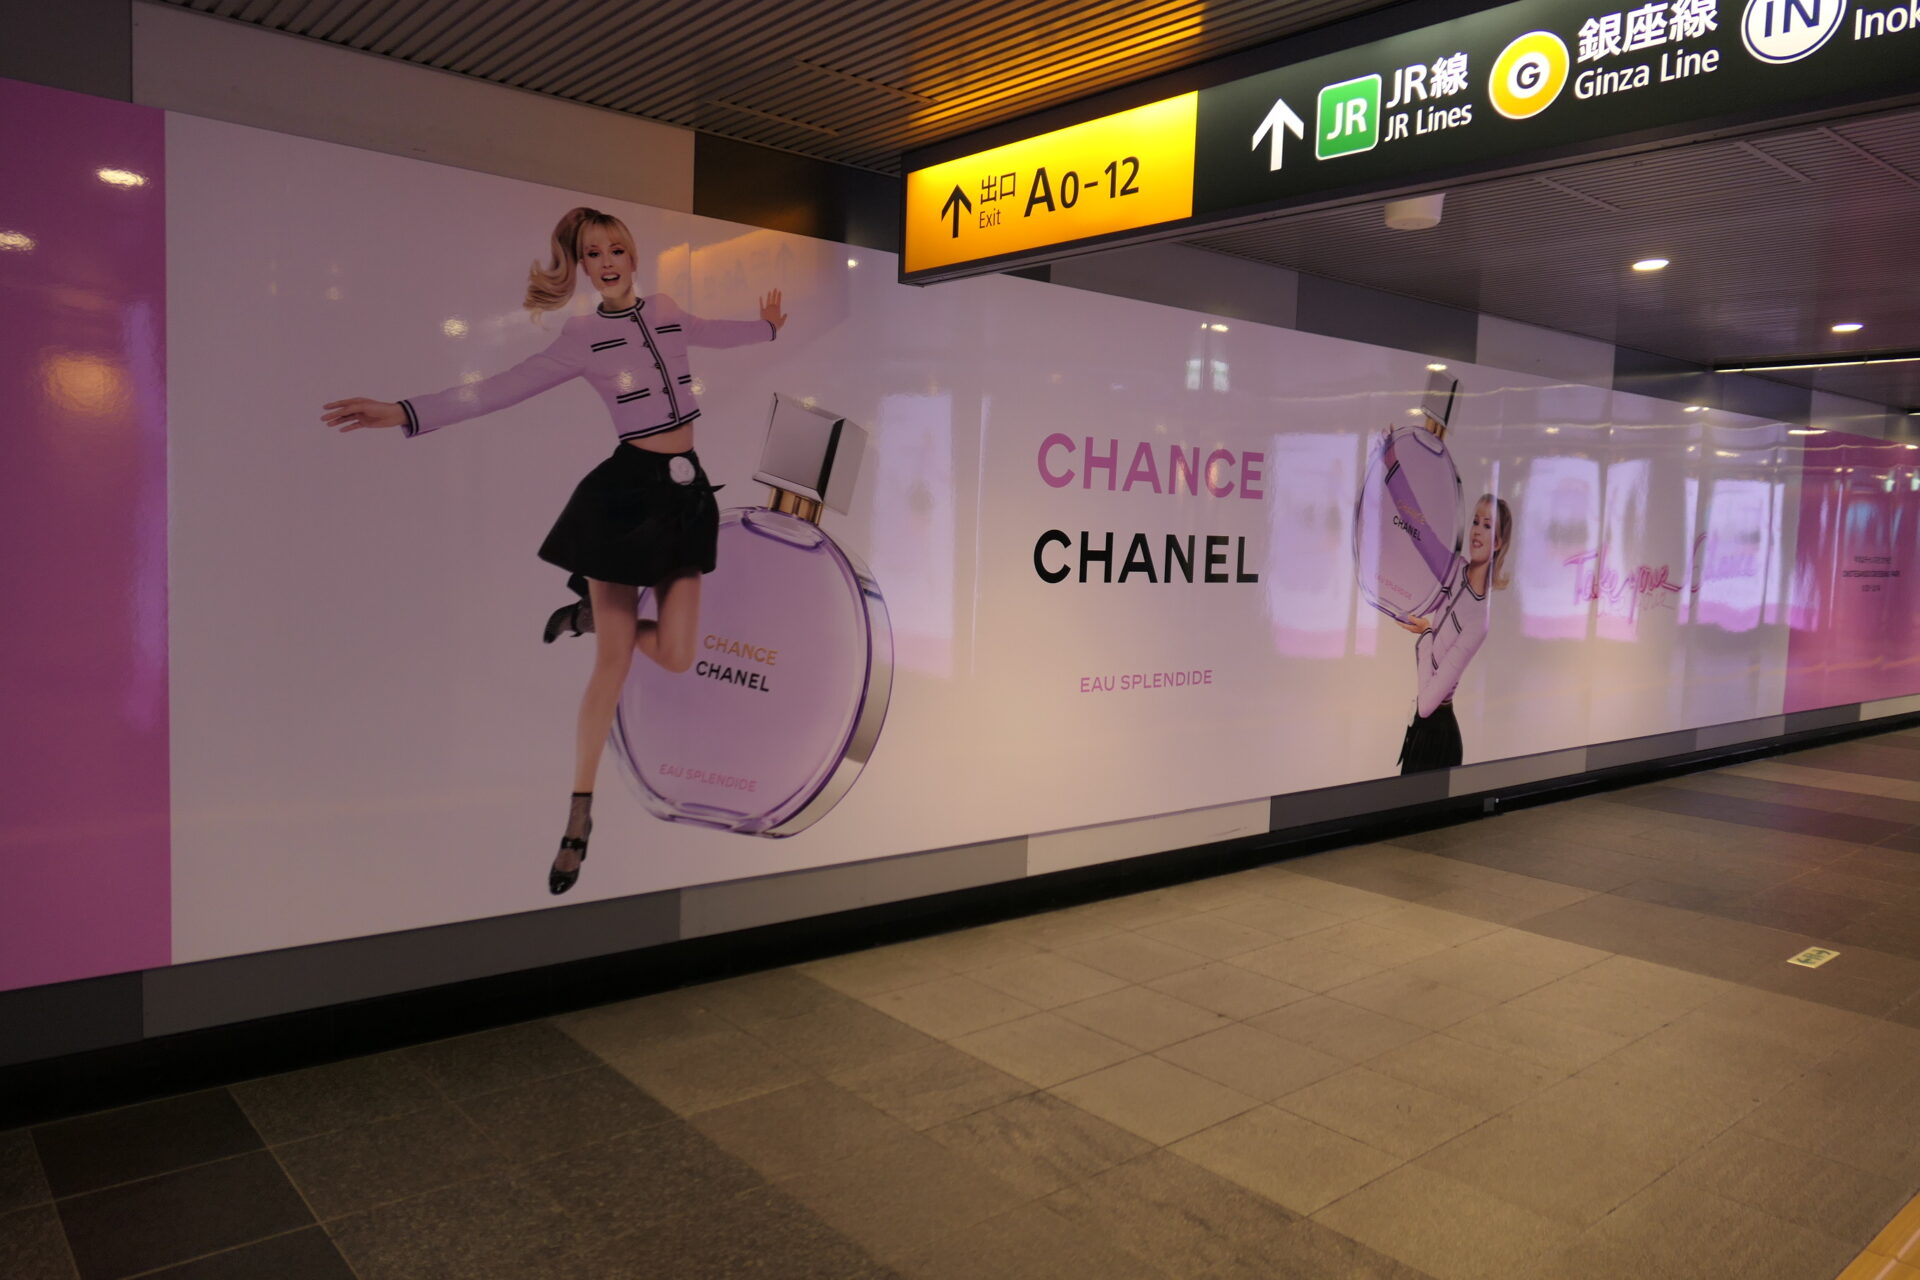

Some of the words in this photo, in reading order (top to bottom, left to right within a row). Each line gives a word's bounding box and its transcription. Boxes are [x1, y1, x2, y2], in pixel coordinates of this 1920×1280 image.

[1576, 0, 1719, 63] 銀座線
[1764, 0, 1823, 38] IN
[1385, 52, 1469, 109] JR線
[1515, 61, 1541, 90] G
[1574, 65, 1650, 100] Ginza
[1660, 48, 1720, 83] Line
[1326, 97, 1368, 140] JR
[1384, 113, 1409, 142] JR
[1416, 104, 1473, 135] Lines
[980, 171, 1016, 205] 出口
[1023, 156, 1140, 218] A0-12
[979, 207, 1001, 229] Exit
[1037, 432, 1265, 500] CHANCE
[1392, 515, 1422, 542] CHANEL
[1033, 528, 1260, 584] CHANEL
[703, 634, 778, 666] CHANCE
[696, 660, 769, 692] CHANEL
[1080, 675, 1115, 693] EAU
[1121, 670, 1213, 690] SPLENDIDE
[659, 763, 683, 778] EAU
[686, 768, 758, 793] SPLENDIDE
